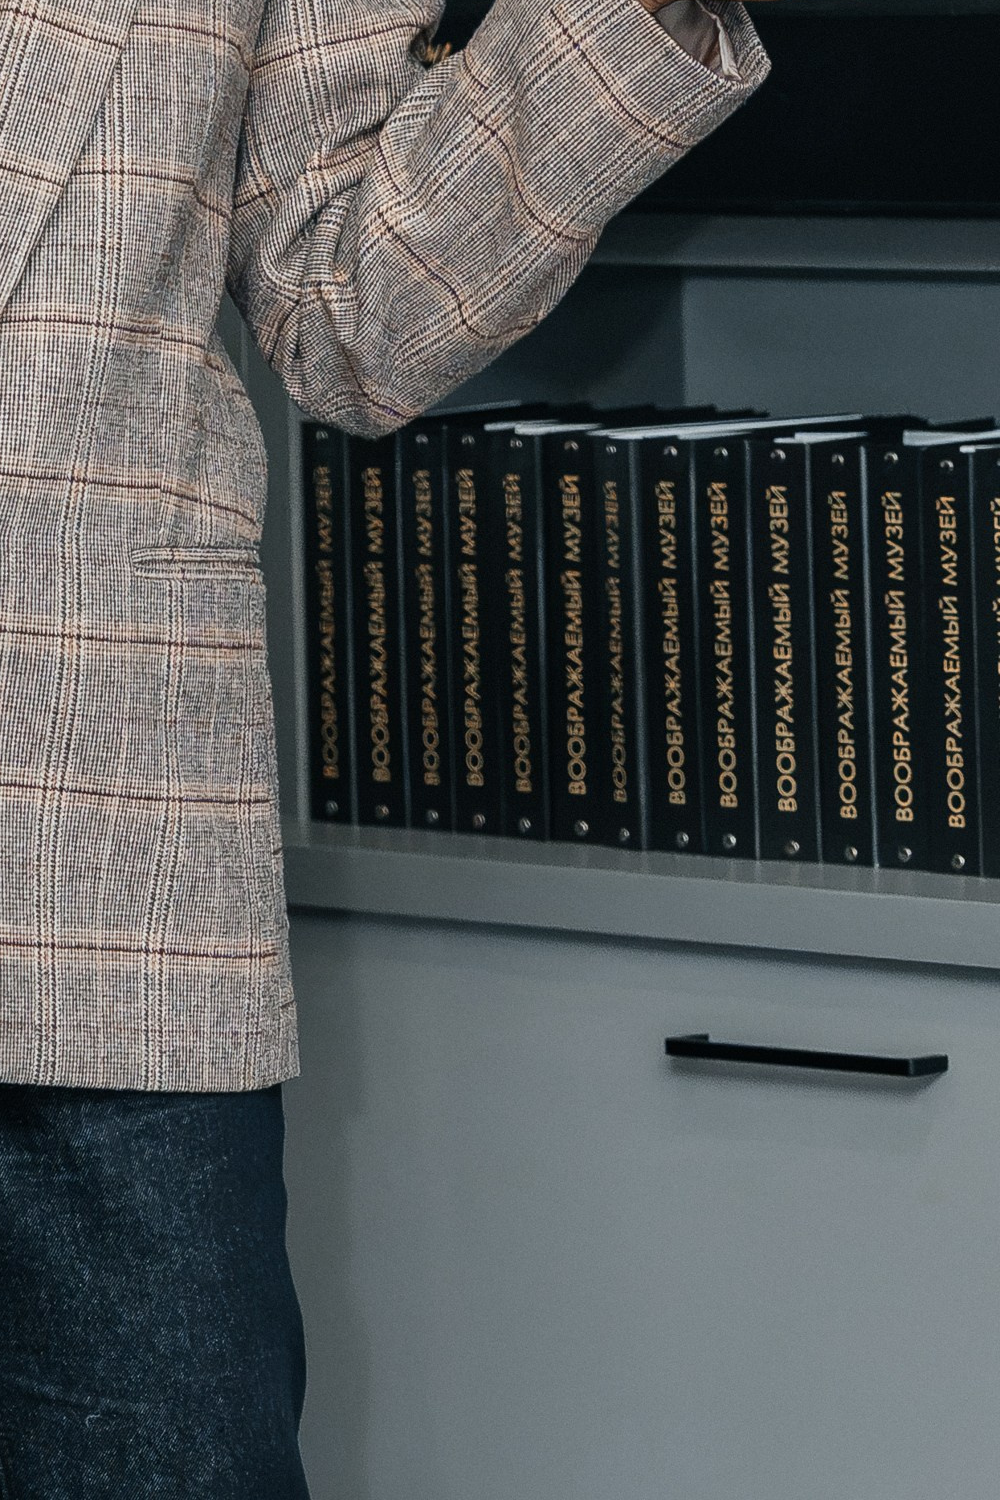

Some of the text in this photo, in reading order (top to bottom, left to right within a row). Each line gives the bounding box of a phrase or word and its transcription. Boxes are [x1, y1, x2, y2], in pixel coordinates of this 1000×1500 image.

[362, 467, 391, 782] ВООБРАЖАЕМЫЙ МУЗЕЙ
[455, 468, 485, 786] ВООБРАЖАЕМЫЙ МУЗЕЙ
[502, 473, 532, 793] ВООБРАЖАЕМЫЙ МУЗЕЙ
[558, 474, 587, 796] ВООБРАЖАЕМЫЙ МУЗЕЙ
[603, 481, 628, 803] ВООБРАЖАЕМЫЙ МУЗЕЙ
[655, 481, 686, 805] ВООБРАЖАЕМЫЙ МУЗЕЙ
[706, 481, 738, 808] ВООБРАЖАЕМЫЙ МУЗЕЙ
[765, 484, 797, 812] ВООБРАЖАЕМЫЙ МУЗЕЙ
[827, 490, 858, 820] ВООБРАЖАЕМЫЙ МУЗЕЙ
[880, 490, 914, 822] ВООБРАЖАЕМЫЙ МУЗЕЙ
[935, 495, 966, 828] ВООБРАЖАЕМЫЙ МУЗЕЙ
